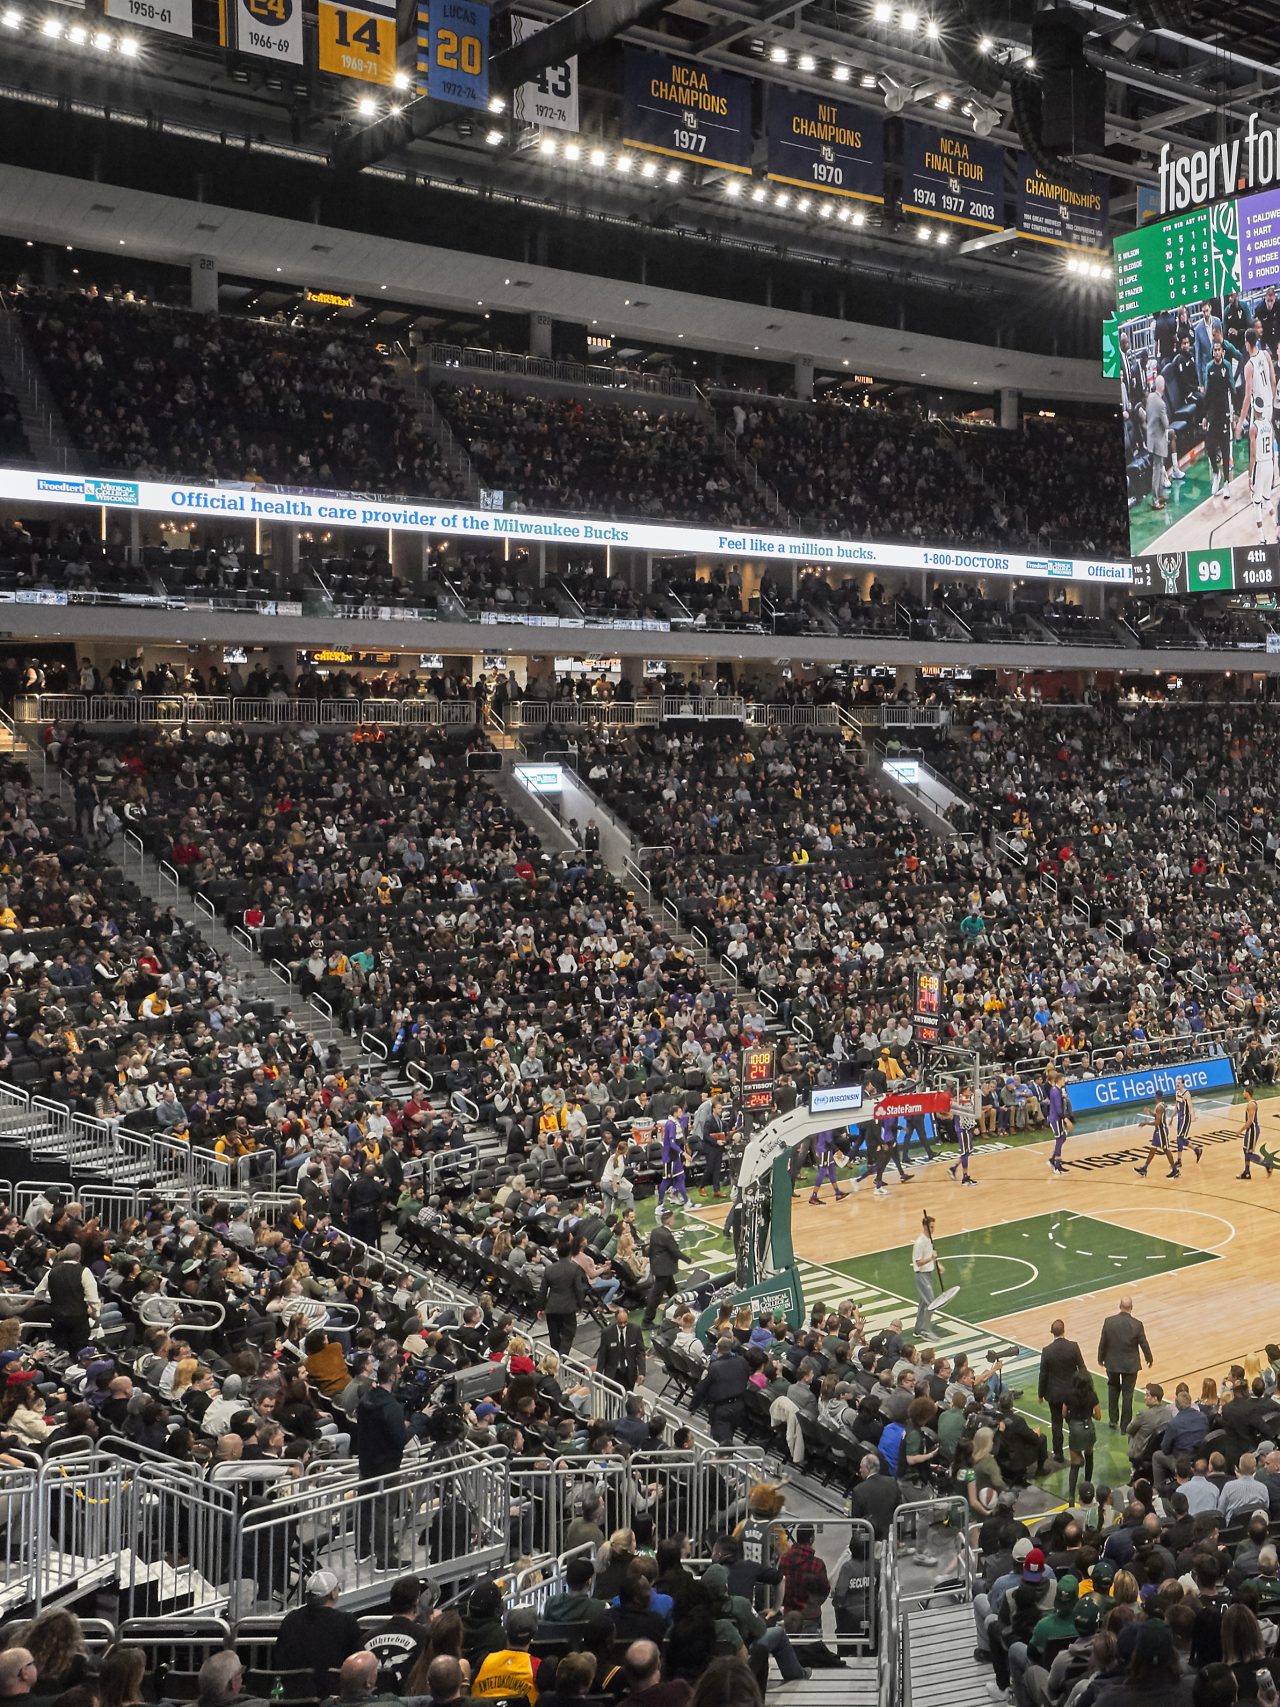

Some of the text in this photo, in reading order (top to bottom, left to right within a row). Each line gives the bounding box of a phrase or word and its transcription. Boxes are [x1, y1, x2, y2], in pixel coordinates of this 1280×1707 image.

[129, 0, 172, 24] 1958-61
[443, 5, 477, 26] LUCAS
[334, 10, 381, 55] 14
[249, 32, 290, 53] 1966-69
[436, 28, 482, 77] 20
[341, 54, 378, 75] 1968-71
[672, 64, 709, 92] NCAA
[651, 79, 728, 116] CHAMPIONS
[535, 104, 567, 122] 1972-76
[818, 104, 838, 124] NIT
[673, 128, 707, 153] 1977
[792, 116, 862, 149] CHAMPIONS
[940, 137, 969, 159] NCAA
[812, 162, 843, 185] 1970
[925, 152, 983, 182] FINAL FOUR
[1025, 178, 1101, 210] CHAMPIONSHIPS
[912, 188, 995, 220] 1974 1977 2003
[1253, 224, 1273, 237] HART
[1165, 251, 1173, 260] 10
[1255, 251, 1279, 265] MCGEE
[1165, 263, 1173, 273] 24
[1255, 264, 1280, 278] RONDO
[1262, 436, 1271, 455] 12
[39, 480, 84, 493] Froedtert
[95, 494, 137, 504] WISCONSIN
[171, 491, 629, 541] Official health care provider of the Milwaukee Bucks
[718, 536, 877, 560] Feel like a million bucks.
[1247, 549, 1266, 563] 4th
[923, 553, 1009, 570] 1-800-DOCTORS
[1198, 560, 1221, 582] 99
[1087, 565, 1126, 578] Official
[1242, 569, 1273, 584] 10:08
[314, 653, 353, 662] CHICKEN
[920, 976, 939, 990] 10:08
[920, 1016, 939, 1026] TISSOT
[750, 1053, 770, 1065] 10:08
[750, 1065, 767, 1080] 24
[751, 1082, 773, 1090] TISSOT
[1095, 1081, 1119, 1103] GE
[828, 1093, 860, 1104] WISCONSIN
[760, 1300, 783, 1309] COLLEGE
[763, 1292, 788, 1302] MEDICAL
[742, 1541, 763, 1565] 68
